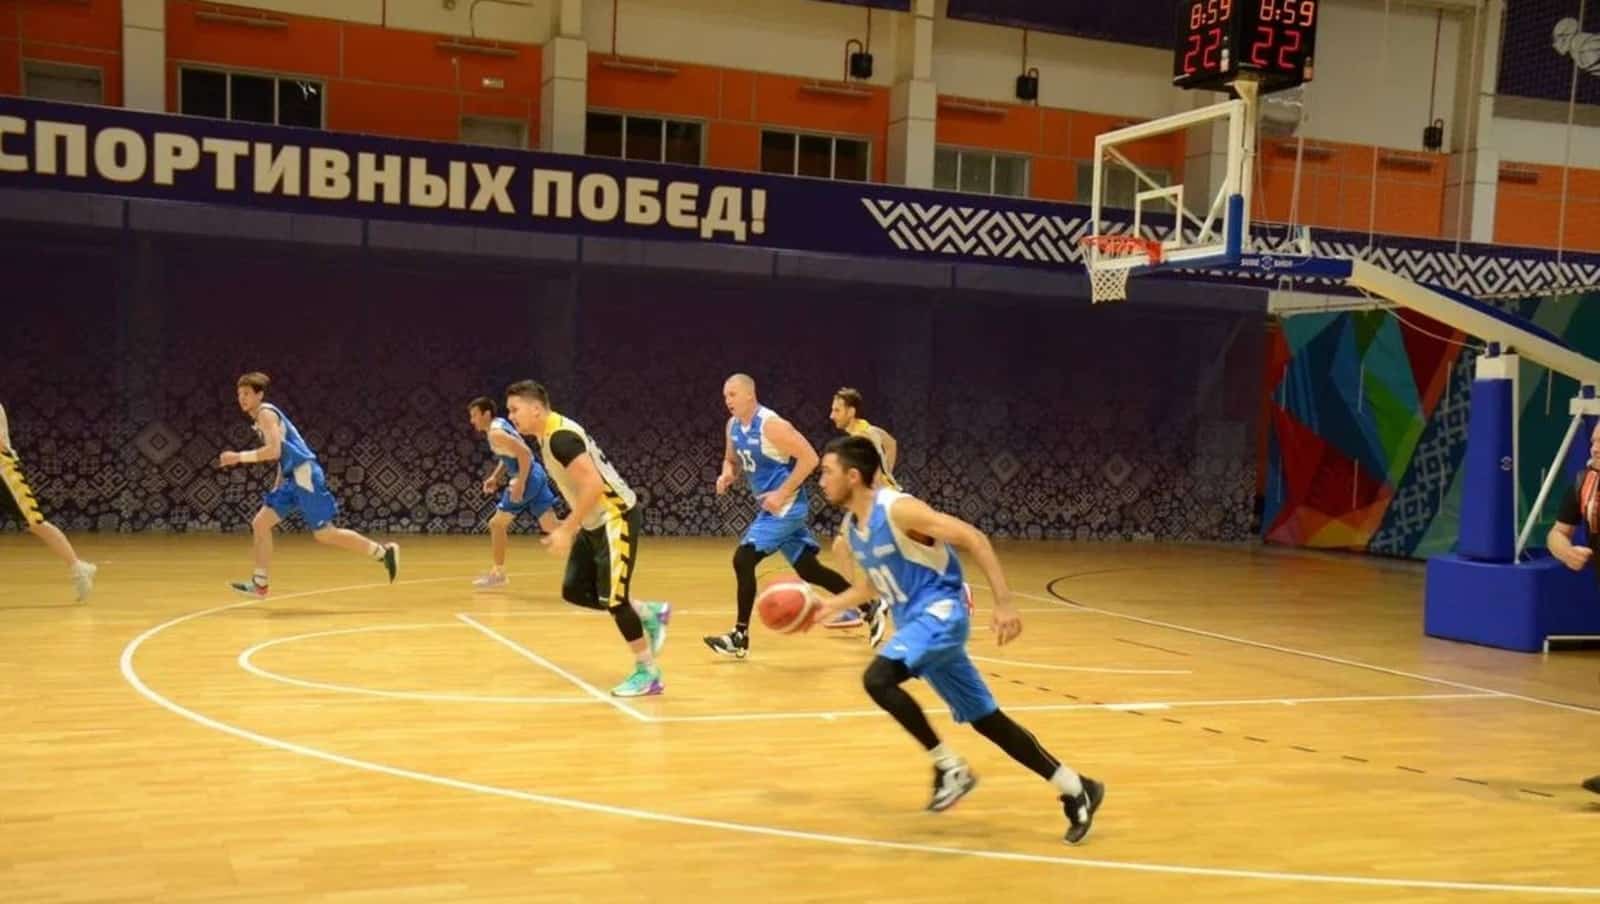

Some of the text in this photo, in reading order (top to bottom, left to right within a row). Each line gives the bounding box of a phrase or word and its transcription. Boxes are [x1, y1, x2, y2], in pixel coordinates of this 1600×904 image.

[1190, 0, 1233, 30] 8:59
[1259, 0, 1314, 27] 8:59
[1183, 28, 1222, 74] 22
[1251, 26, 1301, 69] 22
[0, 114, 767, 242] СПОРТИВНЫХ ПОБЕД!
